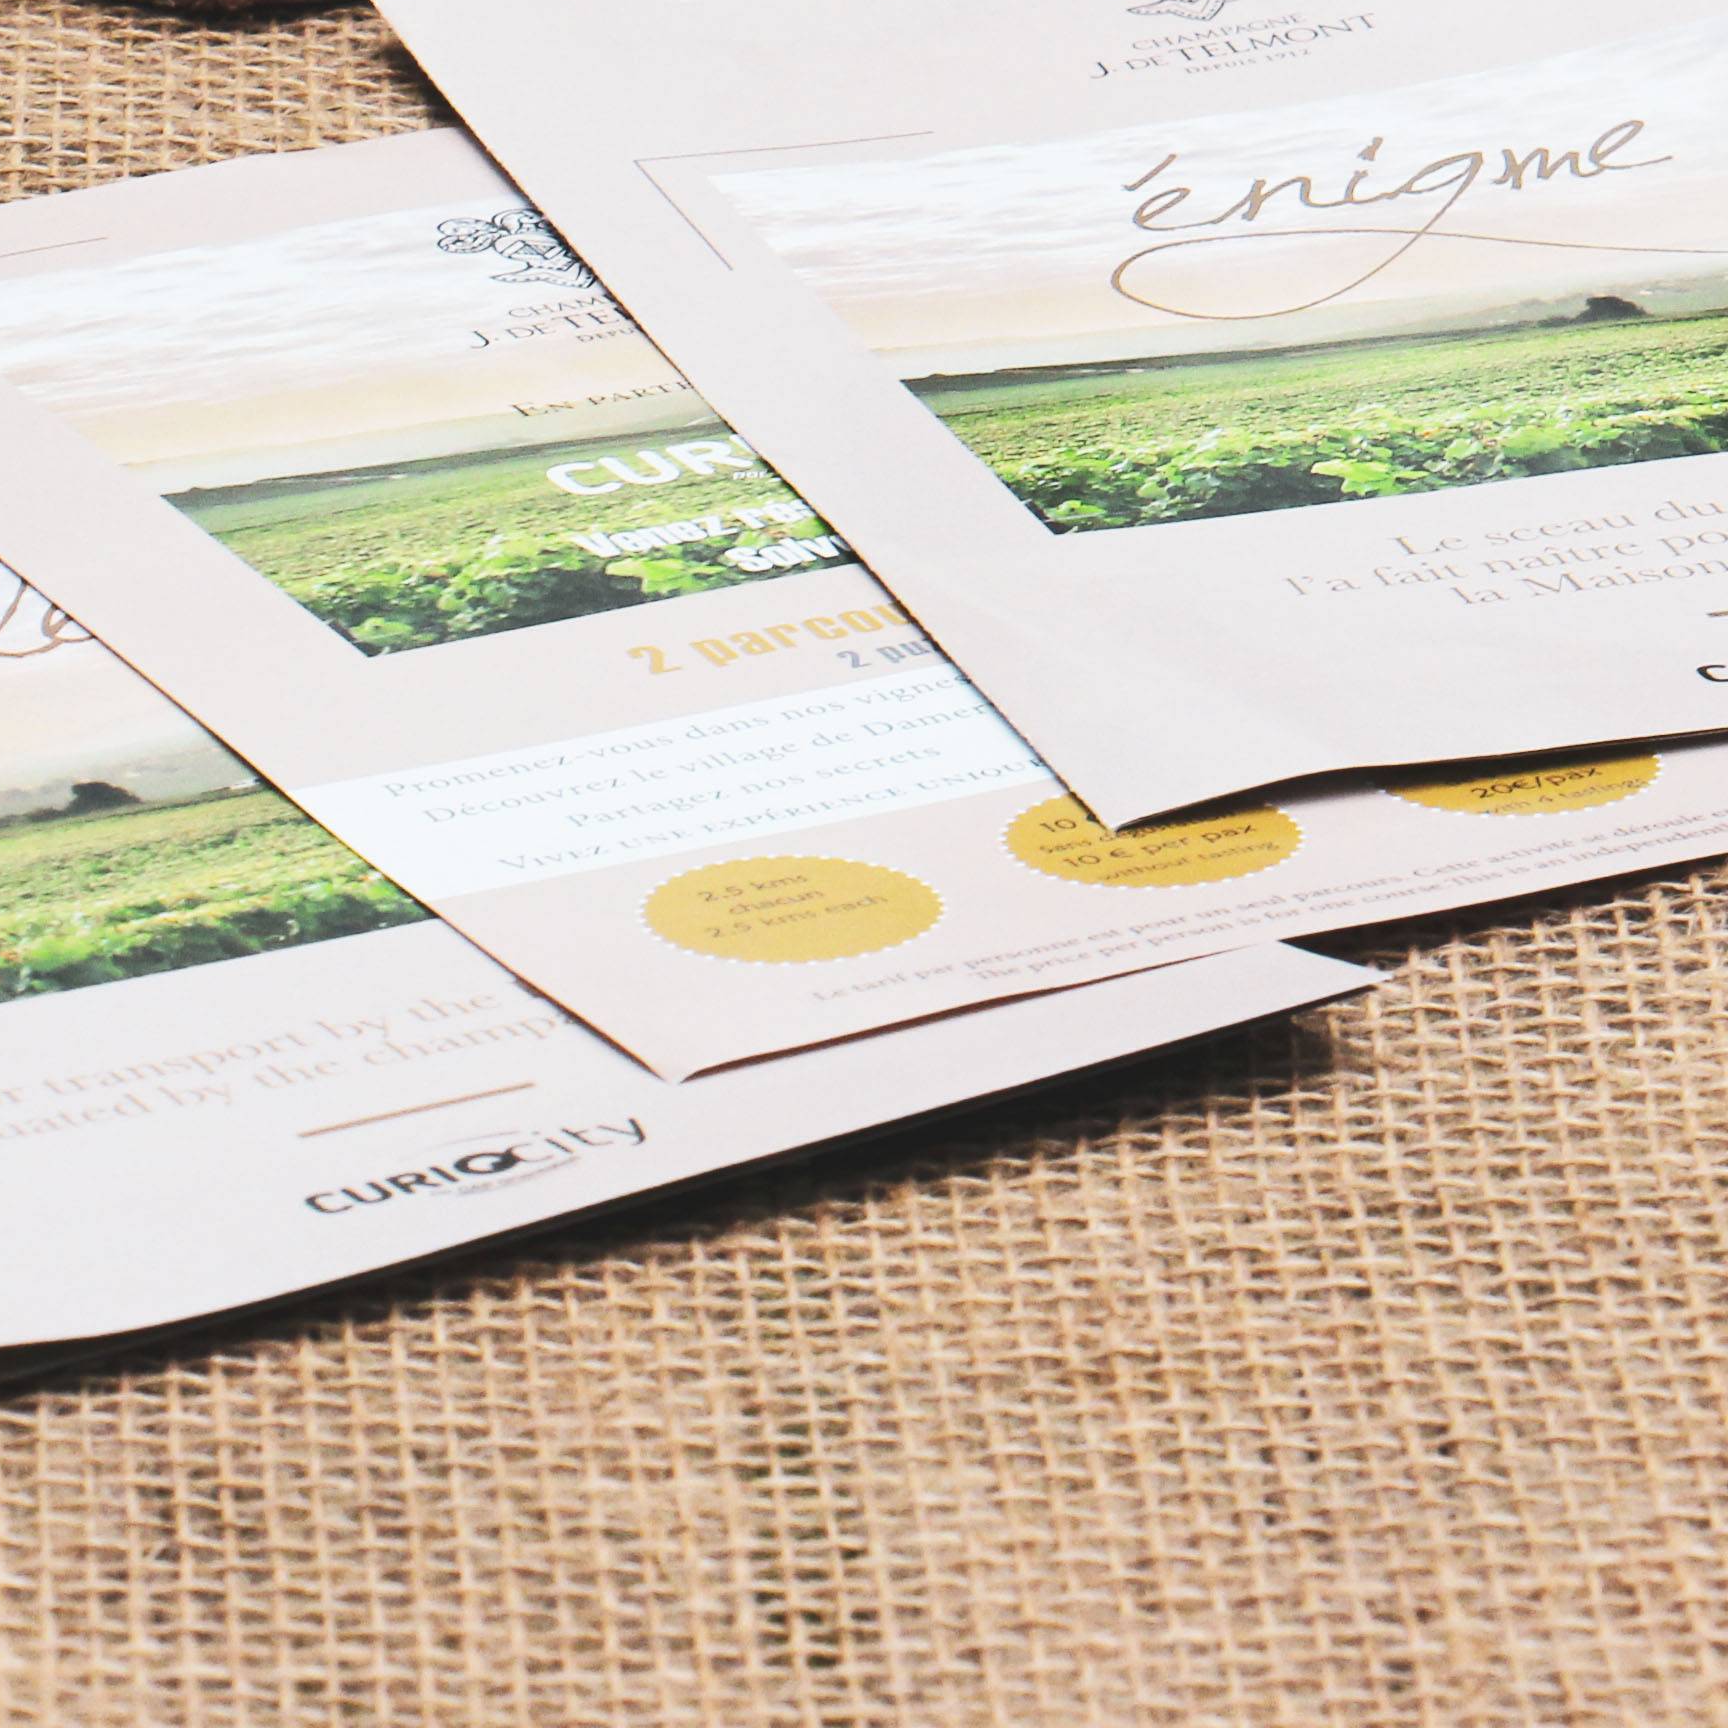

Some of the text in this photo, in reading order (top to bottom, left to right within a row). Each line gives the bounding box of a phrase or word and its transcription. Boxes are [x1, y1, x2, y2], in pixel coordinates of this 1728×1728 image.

[1125, 53, 1169, 71] DE
[1168, 12, 1375, 62] TELMONT
[1131, 12, 1306, 52] CHAMPAGNE
[1266, 47, 1312, 63] 1912
[1110, 118, 1672, 320] énigme
[508, 293, 612, 319] CHAM
[505, 323, 557, 339] DE
[576, 327, 637, 343] DEPU
[572, 515, 739, 560] Venez
[1389, 533, 1469, 557] Le
[1484, 512, 1637, 546] sceau
[1653, 498, 1724, 522] du
[1373, 559, 1469, 588] fait
[1479, 540, 1644, 575] naître
[1449, 583, 1511, 606] la
[627, 644, 683, 674] 2
[380, 732, 675, 799] Promenez-vous
[684, 715, 769, 740] dans
[781, 701, 846, 722] nos
[423, 777, 626, 823] Découvrez
[631, 767, 668, 784] le
[677, 740, 801, 774] village
[811, 729, 854, 749] de
[566, 744, 942, 828] Partagez nos secrets
[1040, 818, 1077, 833] 10
[1062, 854, 1101, 868] 10
[1141, 837, 1189, 855] per
[1201, 823, 1258, 843] pax
[42, 1029, 309, 1097] transport
[317, 1015, 390, 1039] by
[408, 993, 502, 1022] the
[158, 1076, 233, 1108] by
[252, 1058, 340, 1092] the
[363, 1016, 562, 1066] champ
